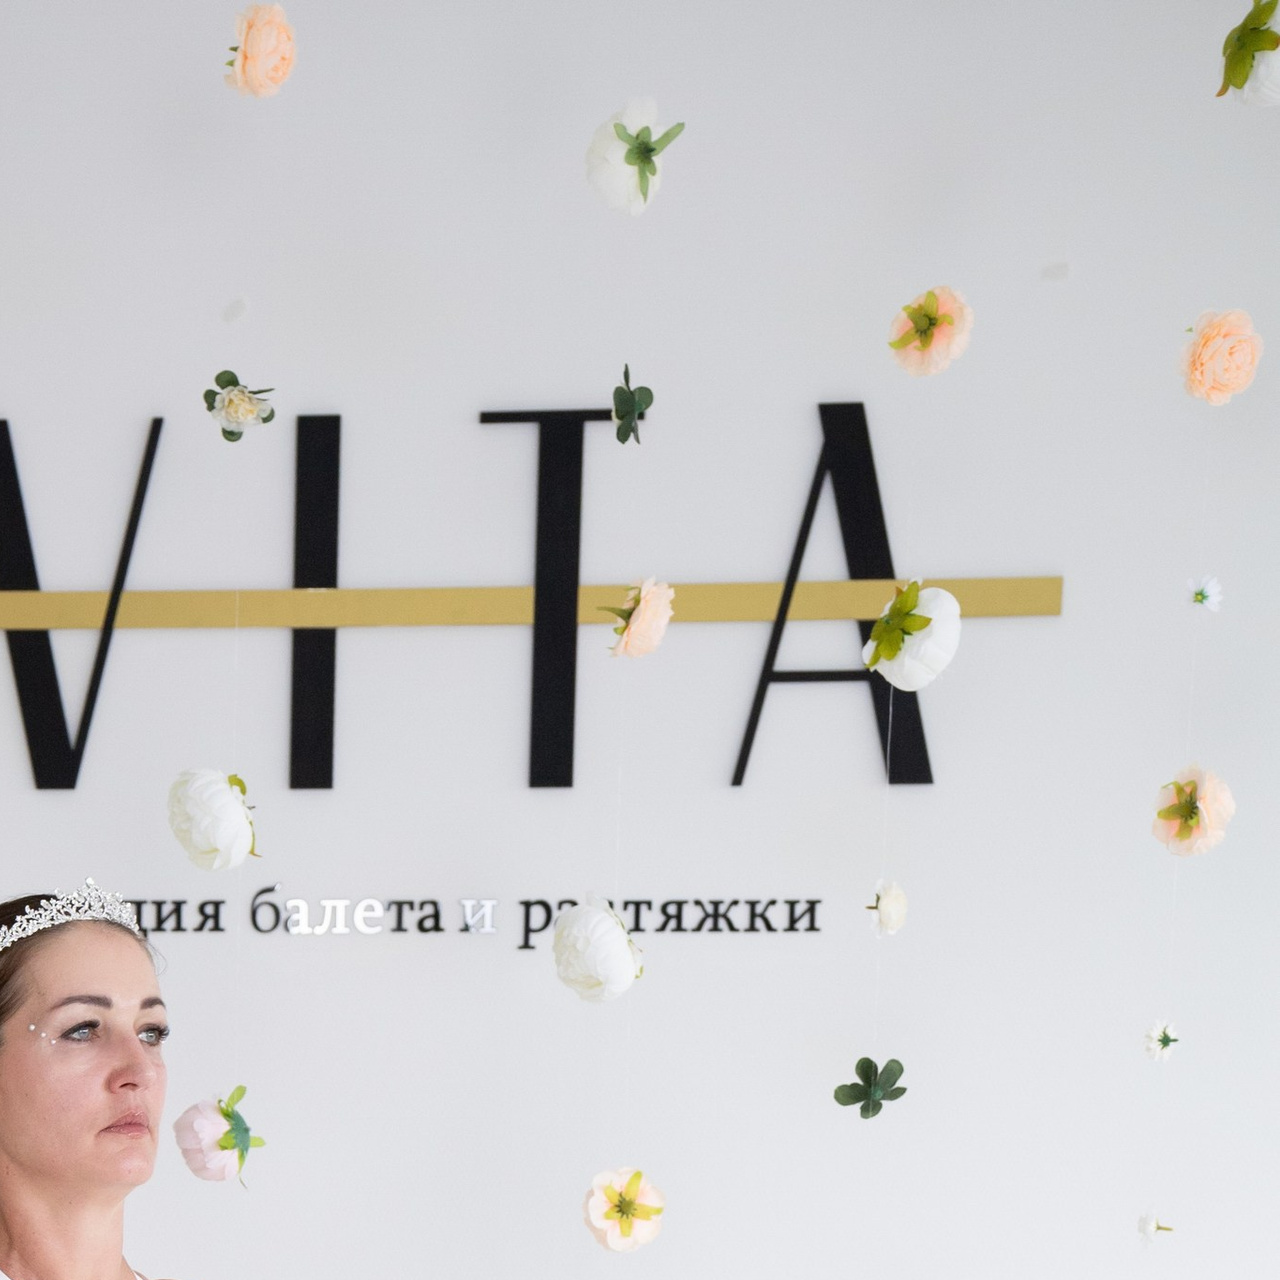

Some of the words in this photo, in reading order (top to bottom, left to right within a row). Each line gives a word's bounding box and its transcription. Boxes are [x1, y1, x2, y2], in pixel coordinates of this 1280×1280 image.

[250, 883, 445, 935] балета
[459, 899, 497, 934] и
[517, 898, 822, 950] ртяжки
